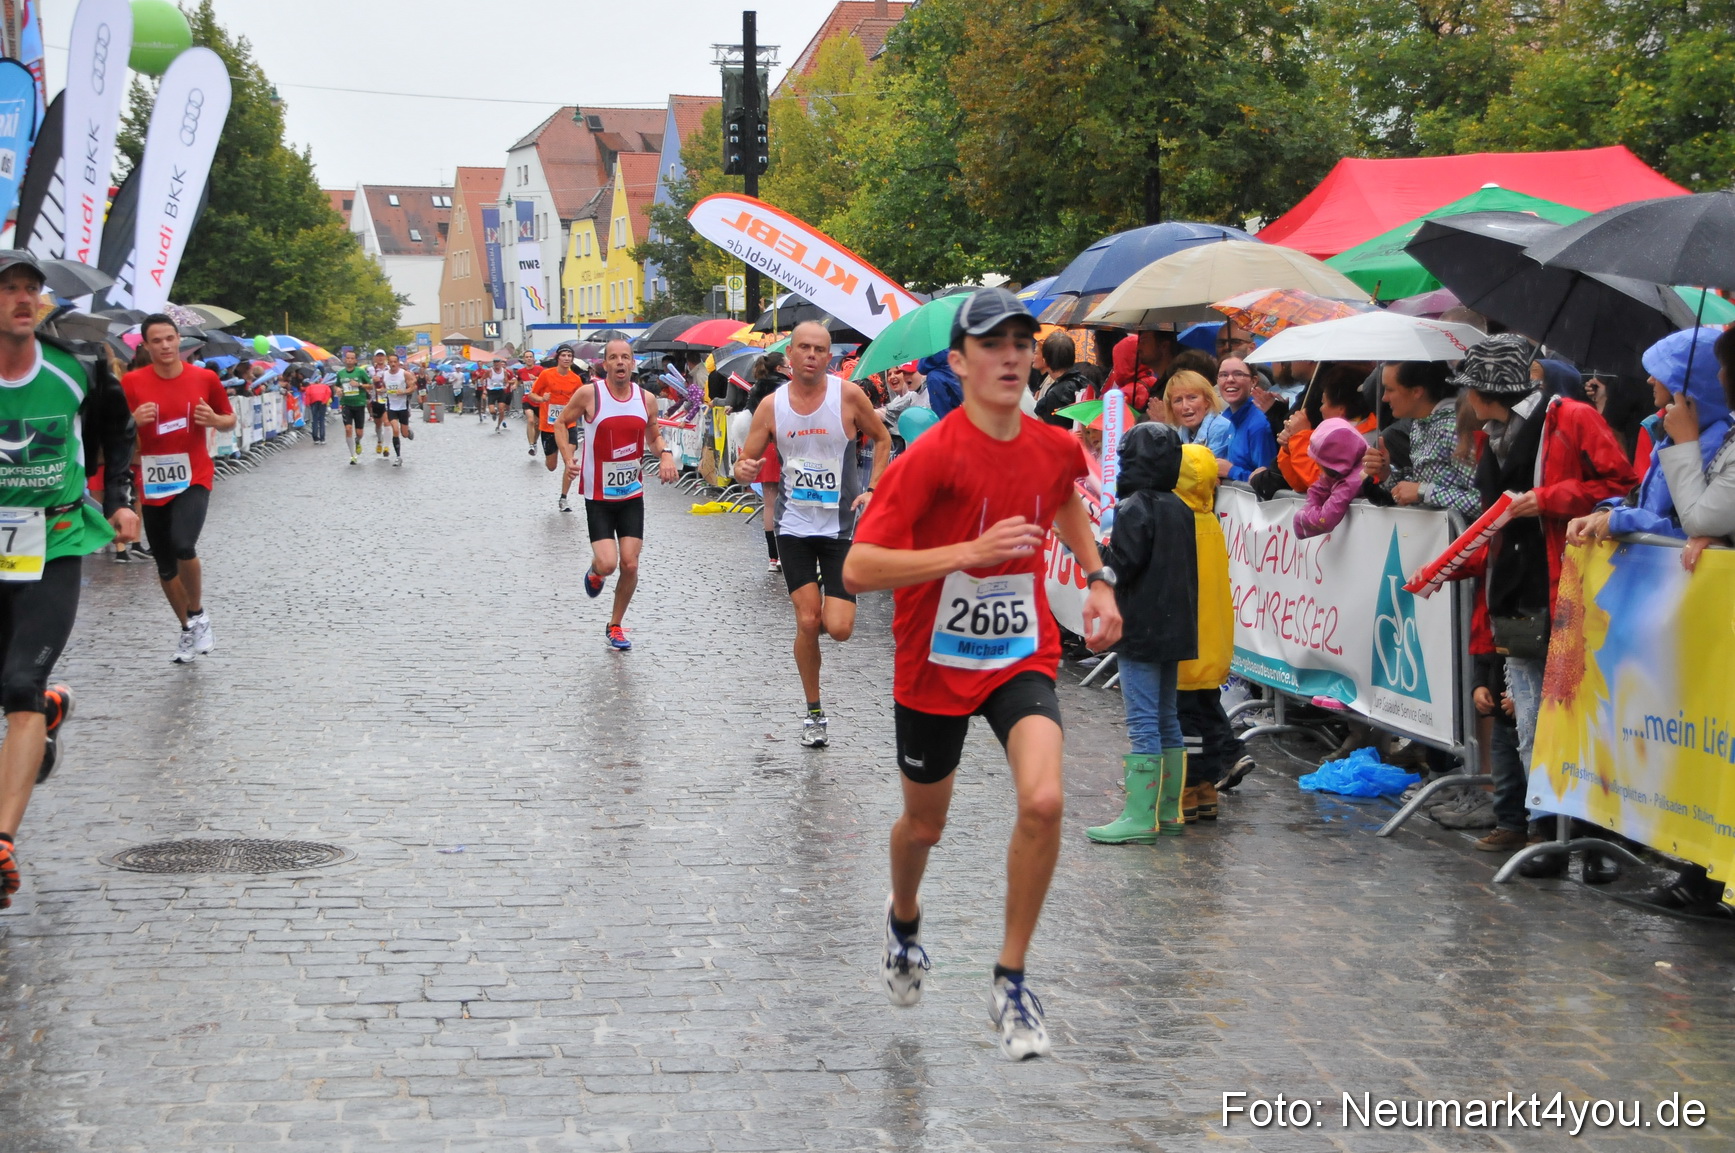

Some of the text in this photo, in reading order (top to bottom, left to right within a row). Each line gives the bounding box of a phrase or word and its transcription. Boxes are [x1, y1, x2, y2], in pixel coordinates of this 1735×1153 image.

[76, 119, 100, 263] Audi BKK
[150, 164, 187, 288] Audi BKK
[798, 428, 829, 437] KLEBL
[1104, 393, 1118, 486] TUI ReiseCenter
[147, 464, 187, 483] 2040
[794, 469, 836, 490] 2049
[946, 597, 1028, 636] 2665
[958, 641, 1009, 656] Michael
[1418, 708, 1433, 727] GmbH
[1703, 715, 1729, 759] Lie
